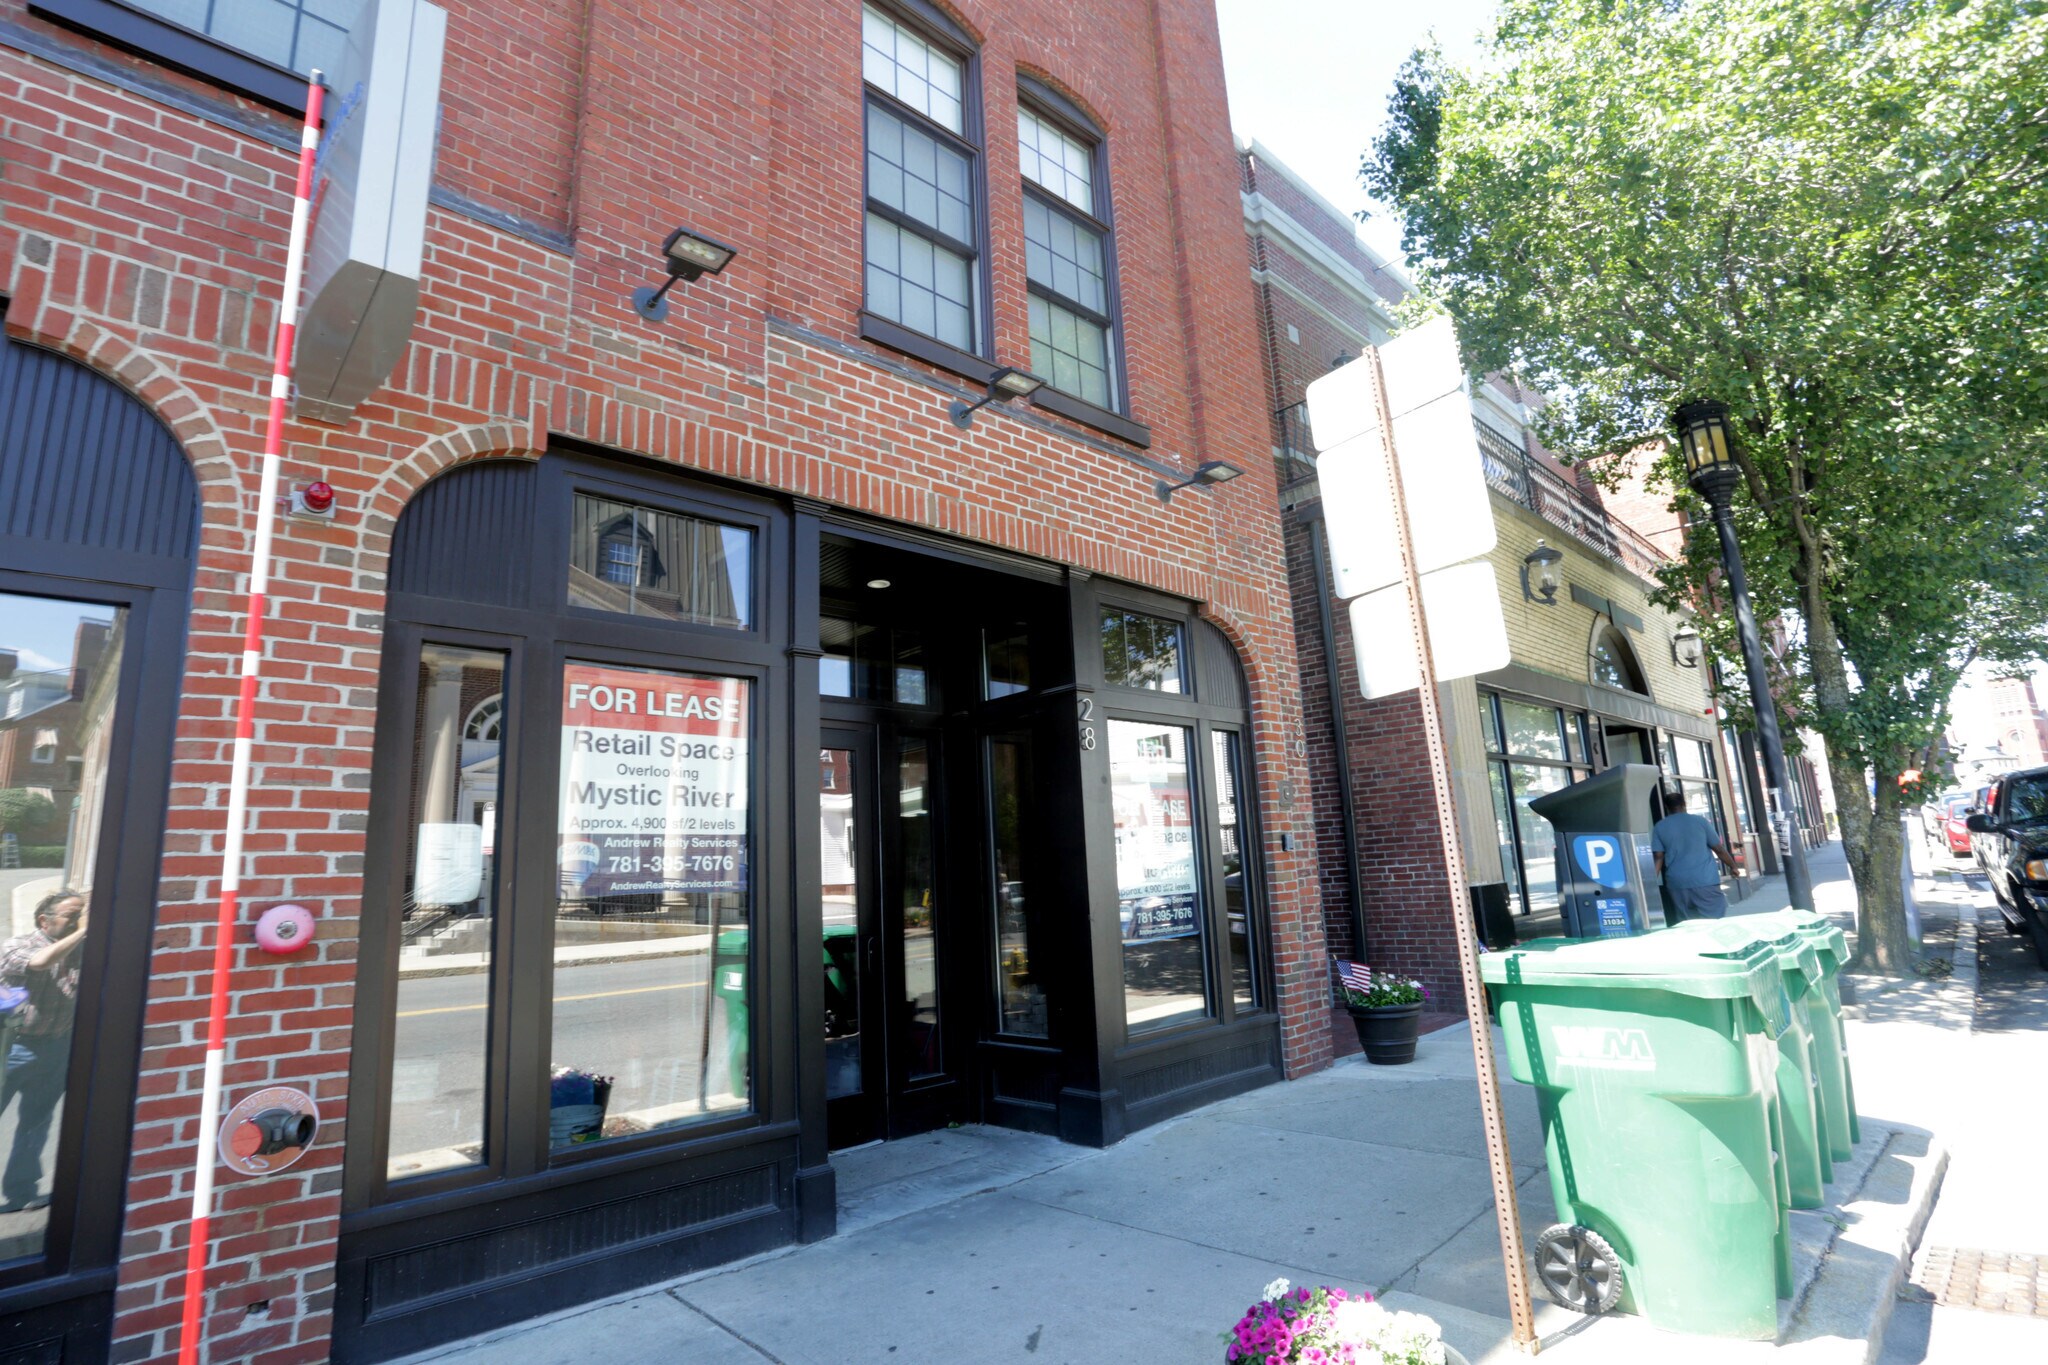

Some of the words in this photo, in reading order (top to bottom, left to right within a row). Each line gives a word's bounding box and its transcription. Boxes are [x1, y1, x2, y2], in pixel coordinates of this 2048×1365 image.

[569, 684, 636, 713] FOR
[646, 691, 740, 723] LEASE
[573, 730, 651, 756] Retail
[660, 736, 735, 762] Space
[617, 763, 699, 781] Overlooking
[570, 781, 662, 810] Mystic
[672, 785, 735, 808] River
[570, 816, 628, 831] Approx.
[631, 817, 667, 831] 4,900
[700, 819, 736, 831] levels
[604, 837, 651, 848] Andrew
[692, 837, 738, 848] Services
[608, 855, 734, 873] 781-395-7676
[1585, 839, 1614, 879] P
[1136, 907, 1193, 924] 781-395-7676
